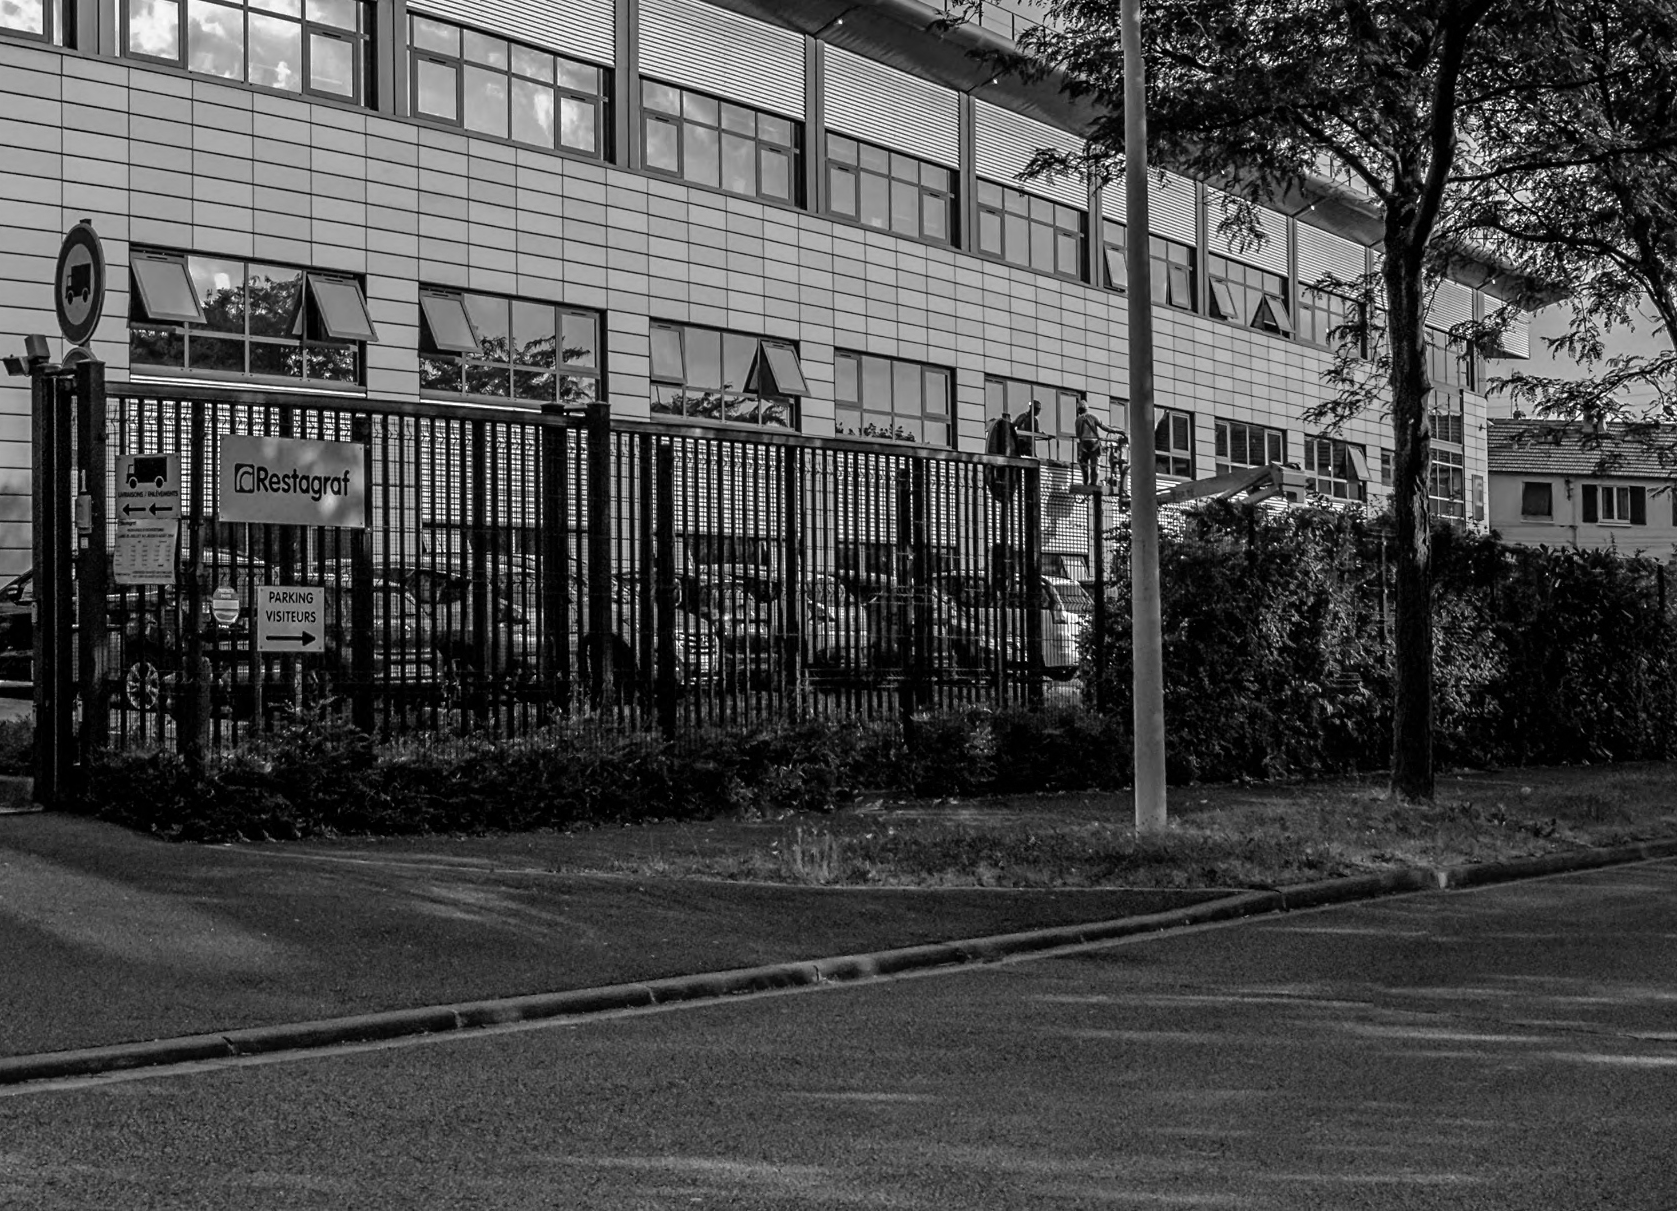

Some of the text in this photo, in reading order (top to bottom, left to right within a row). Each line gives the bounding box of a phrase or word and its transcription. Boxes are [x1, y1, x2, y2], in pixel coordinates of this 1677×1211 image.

[256, 466, 350, 502] Restagraf
[269, 591, 314, 604] PARKING
[266, 610, 316, 623] VISITEURS
